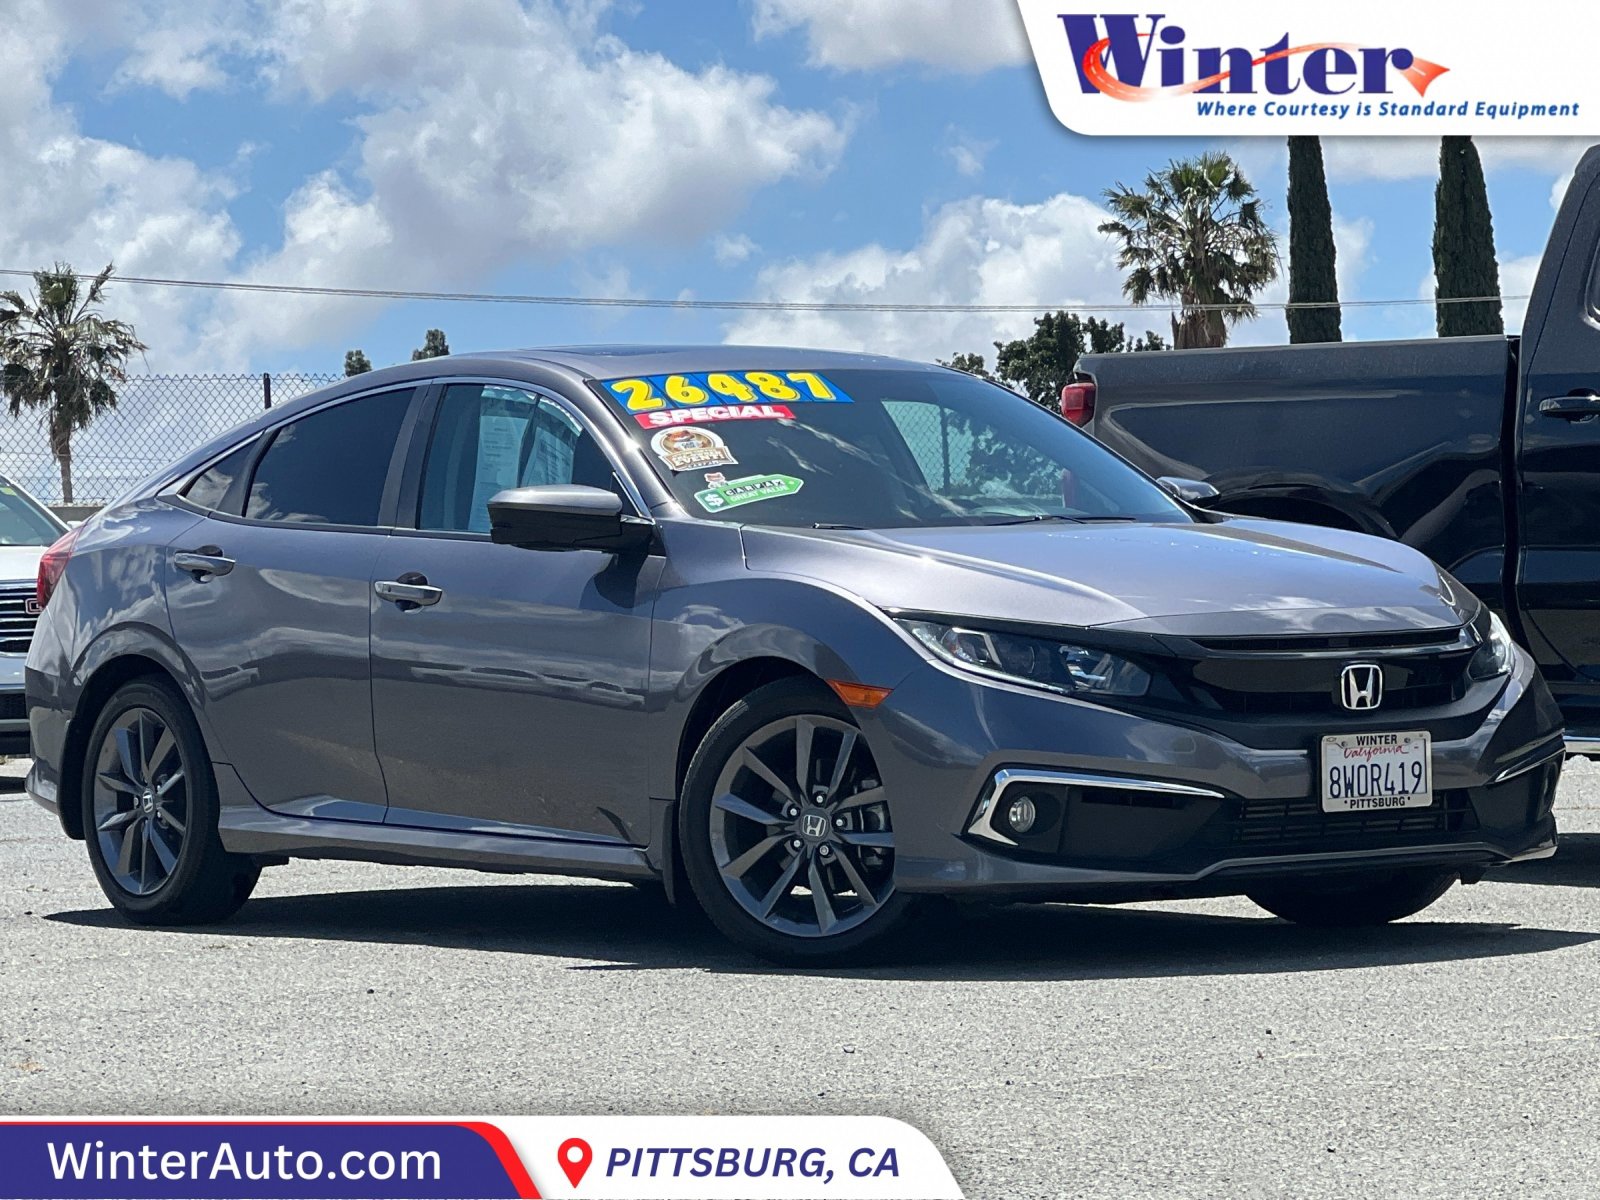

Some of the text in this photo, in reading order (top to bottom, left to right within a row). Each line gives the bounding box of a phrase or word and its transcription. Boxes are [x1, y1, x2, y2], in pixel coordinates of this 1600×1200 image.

[611, 371, 836, 411] 26487
[649, 404, 785, 426] SPECIAL
[724, 479, 785, 496] CARFAX
[730, 484, 789, 502] GREAT VALUE
[1356, 734, 1398, 747] WINTER
[1343, 744, 1410, 762] California
[1329, 760, 1423, 799] 8WOR419
[1349, 796, 1406, 810] PITTSBURG
